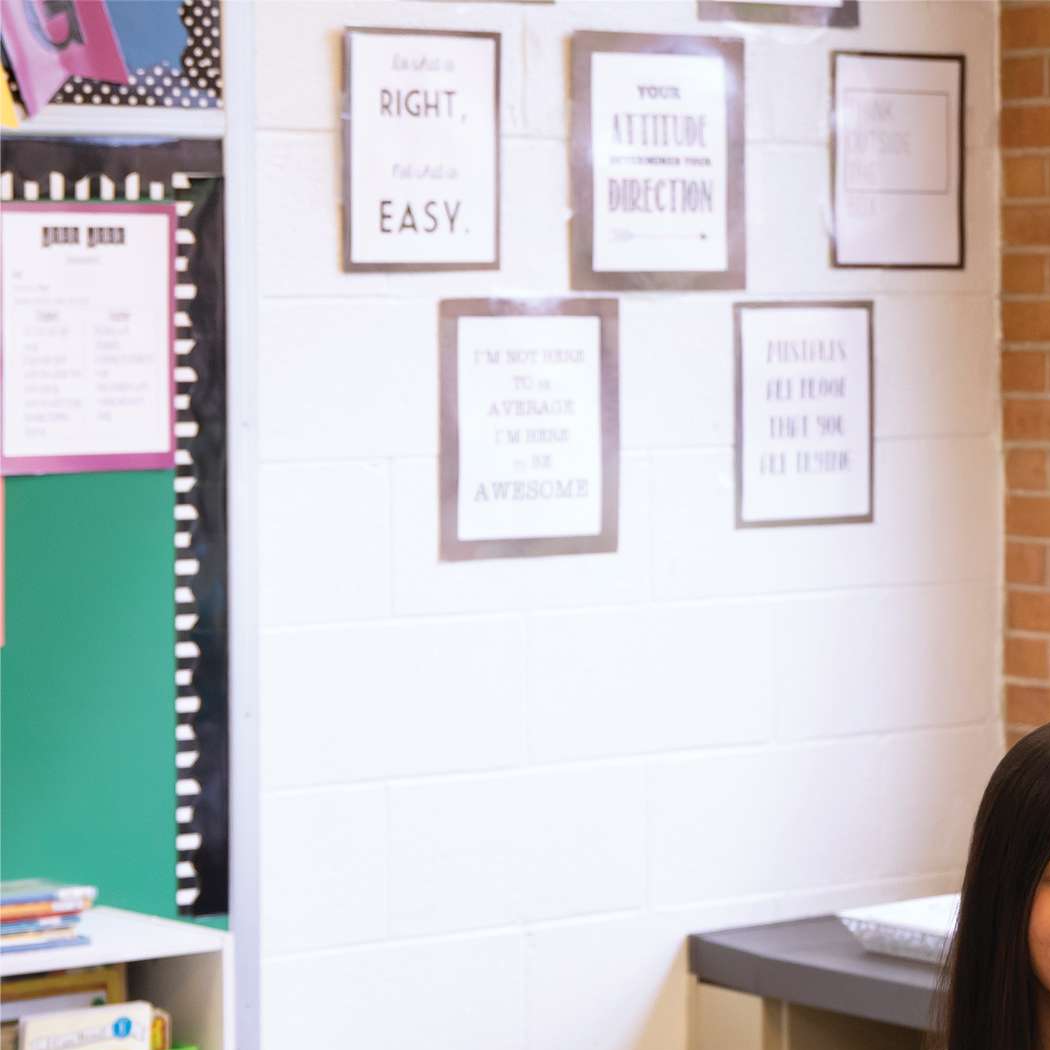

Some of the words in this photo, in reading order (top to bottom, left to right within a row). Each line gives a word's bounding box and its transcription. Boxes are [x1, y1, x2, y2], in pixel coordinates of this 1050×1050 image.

[379, 88, 467, 124] RIGHT,
[637, 85, 680, 99] YOUR
[611, 113, 707, 146] ATTITUDE
[608, 178, 713, 212] DIRECTION
[379, 200, 470, 233] EASY.
[474, 480, 589, 502] AWESOME
